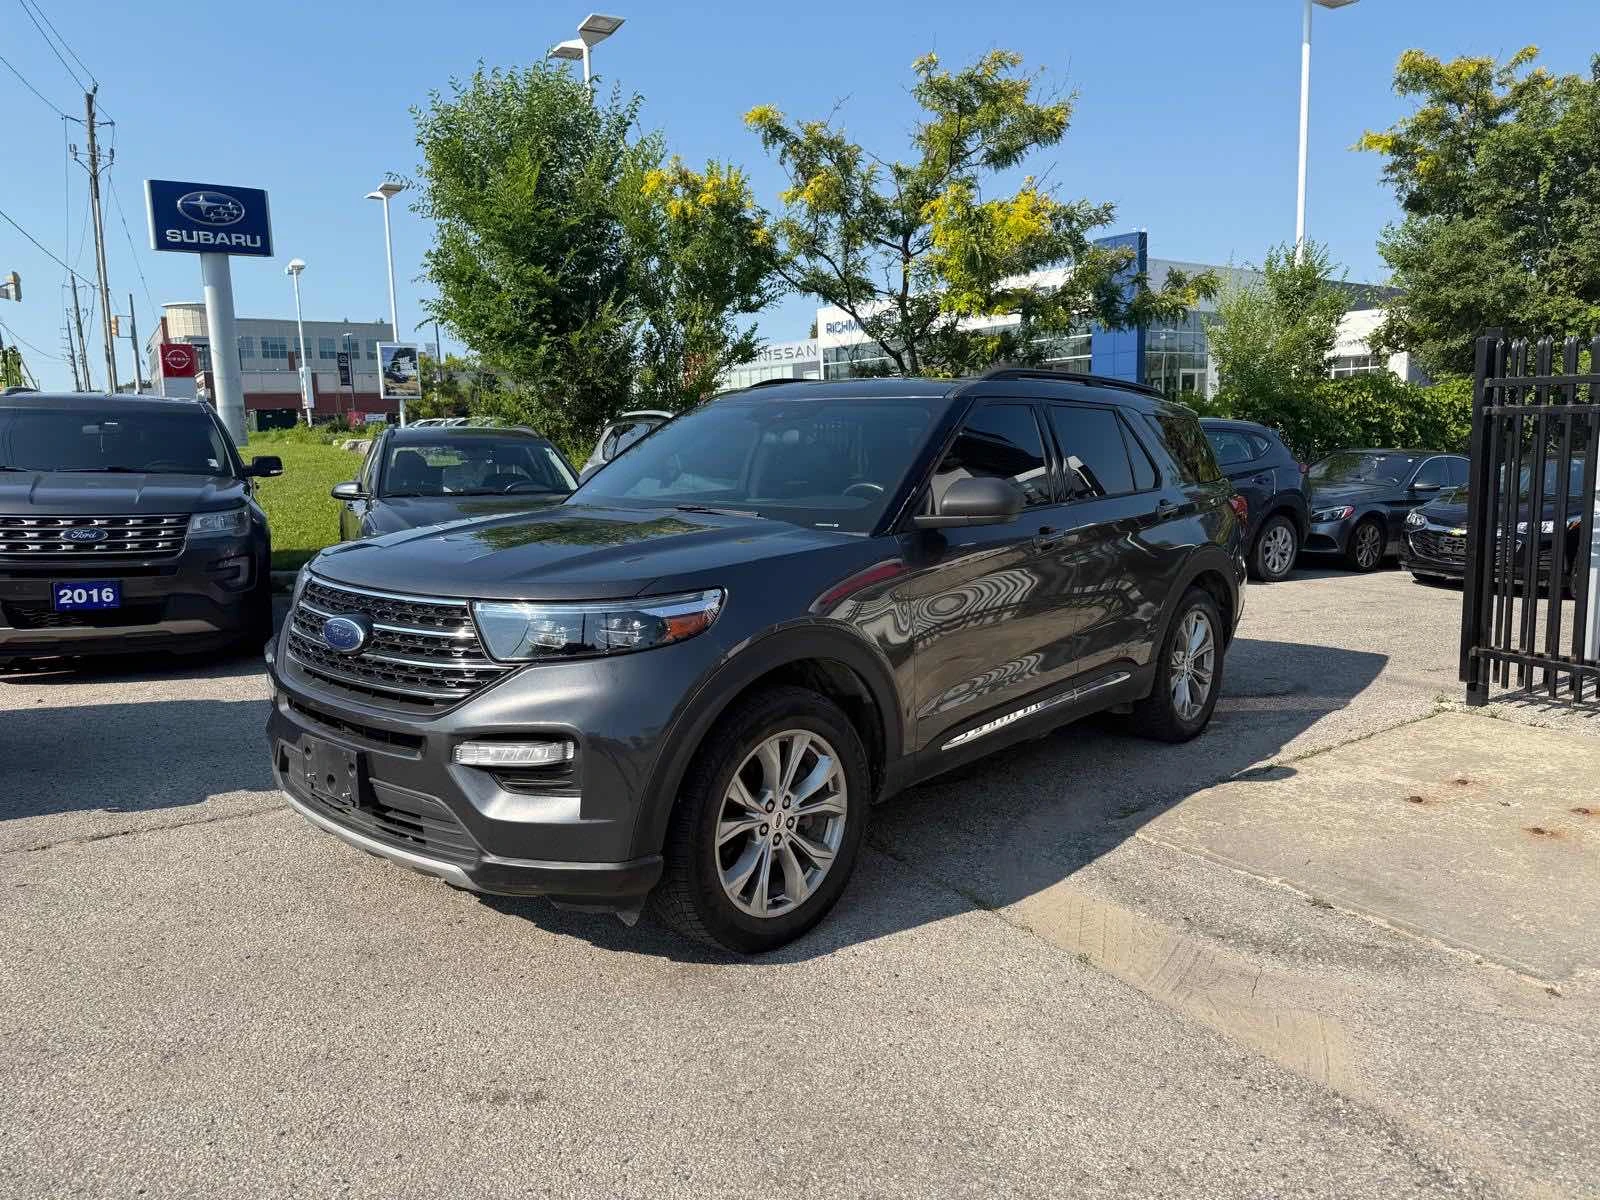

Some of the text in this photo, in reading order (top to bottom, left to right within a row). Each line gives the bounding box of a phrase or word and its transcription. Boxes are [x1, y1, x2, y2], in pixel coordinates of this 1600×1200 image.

[165, 229, 261, 248] SUBARU
[71, 529, 97, 539] Ford
[58, 587, 114, 604] 2016
